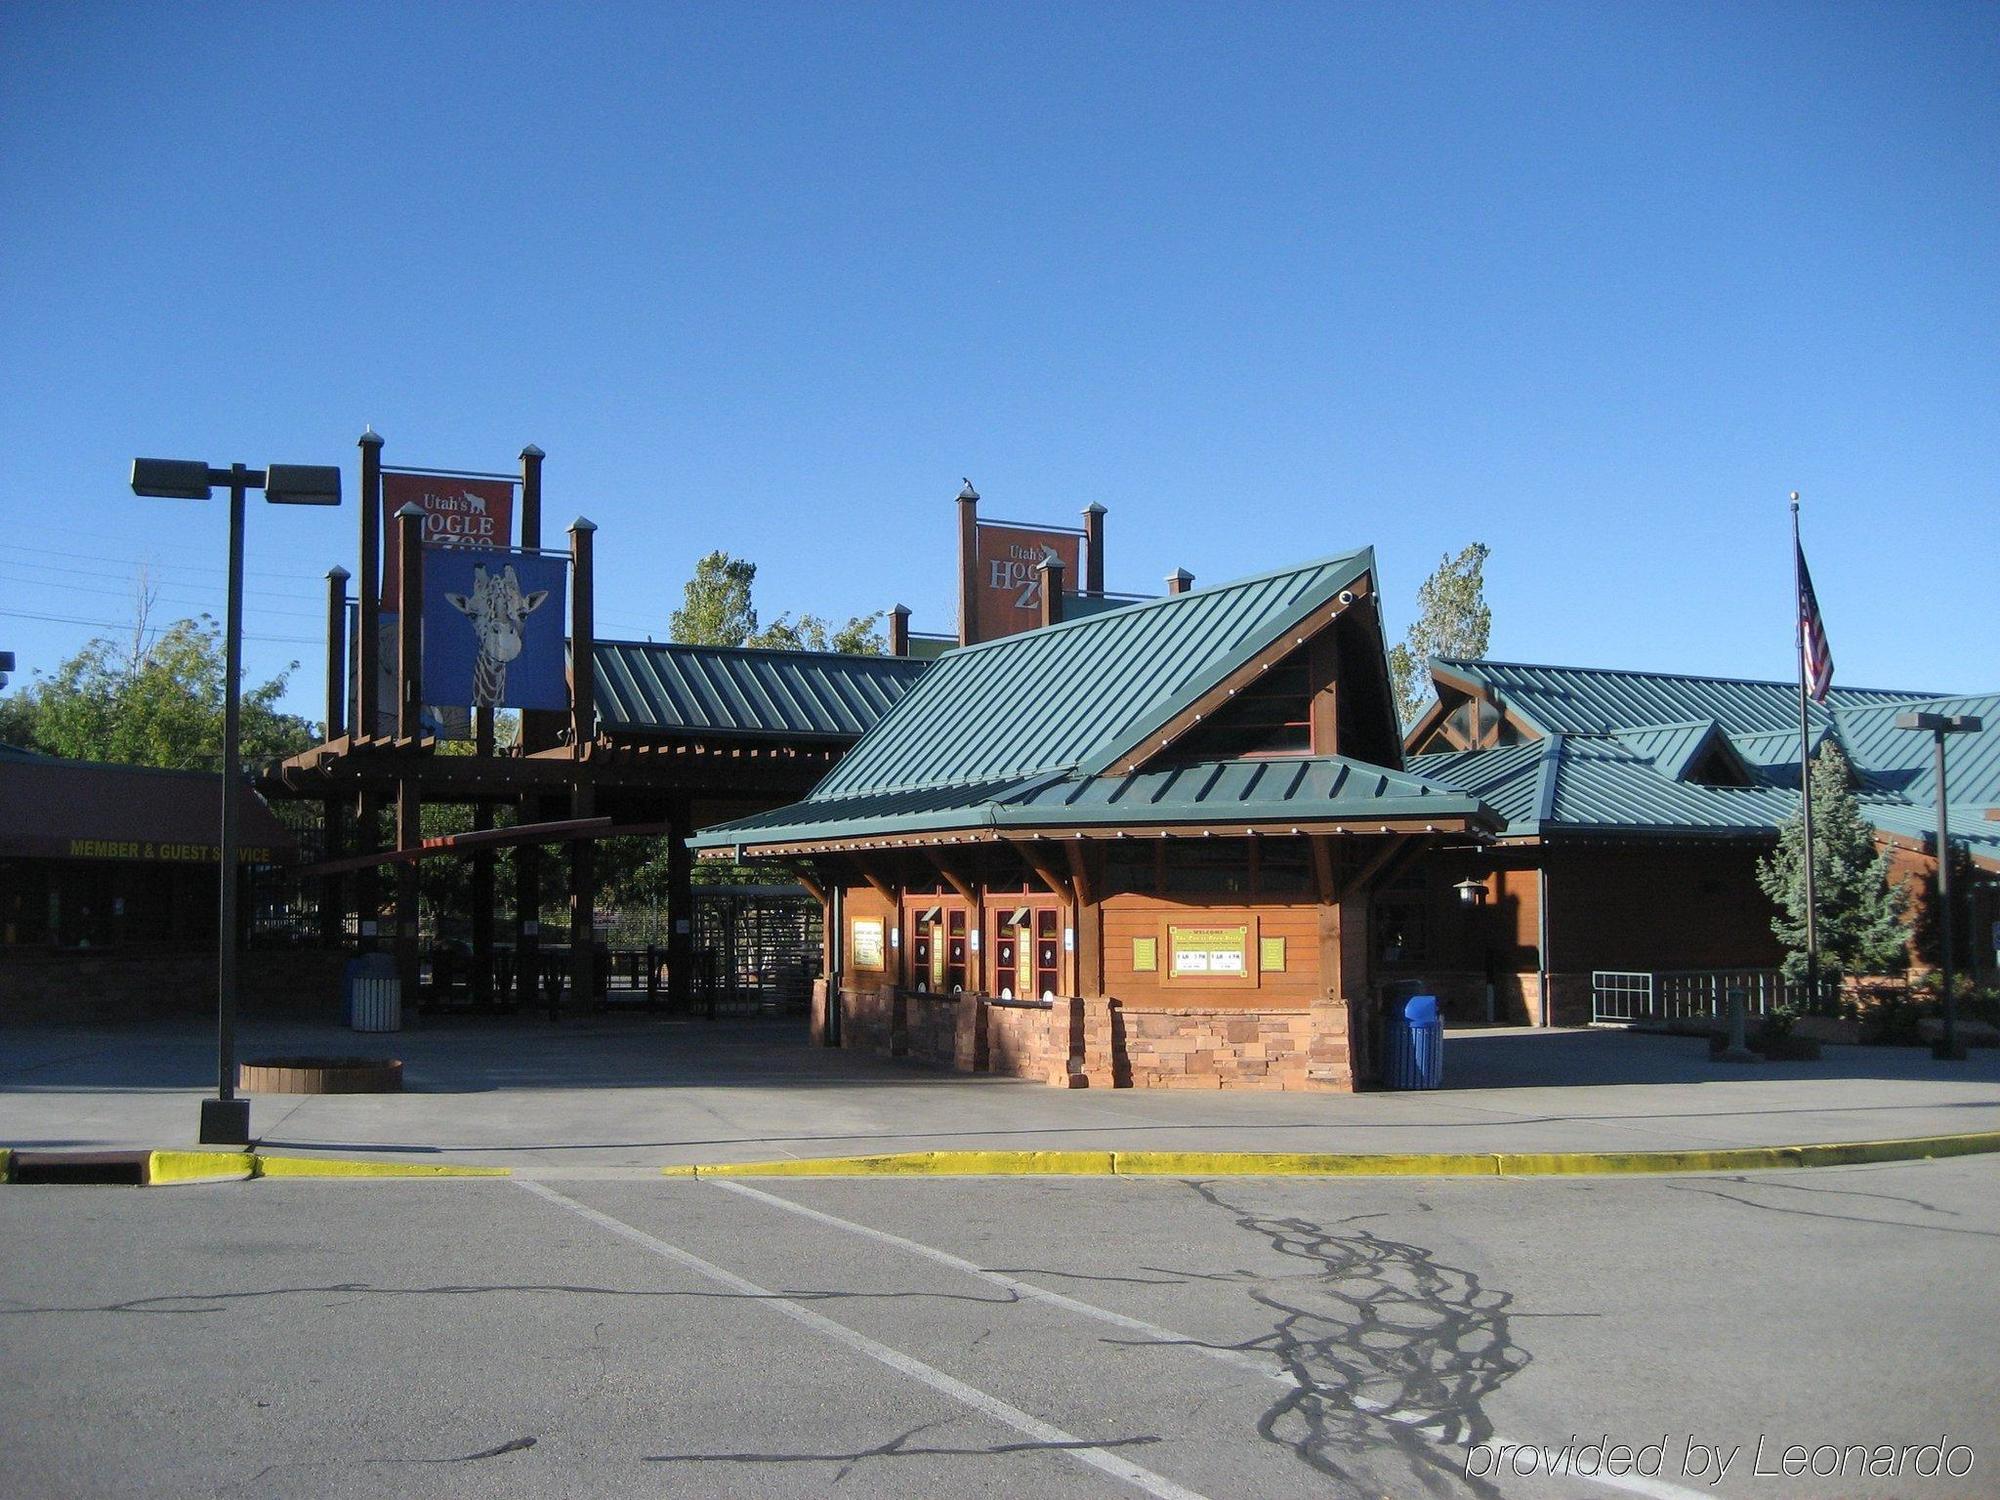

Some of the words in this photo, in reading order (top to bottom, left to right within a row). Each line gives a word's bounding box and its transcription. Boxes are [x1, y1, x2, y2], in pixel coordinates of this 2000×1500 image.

[424, 493, 468, 511] Utah's
[421, 513, 495, 540] OGLE
[1010, 545, 1044, 561] Utah's
[70, 839, 139, 858] MEMBER
[144, 844, 154, 859] &
[159, 844, 208, 860] GUEST
[212, 846, 272, 863] SVICE
